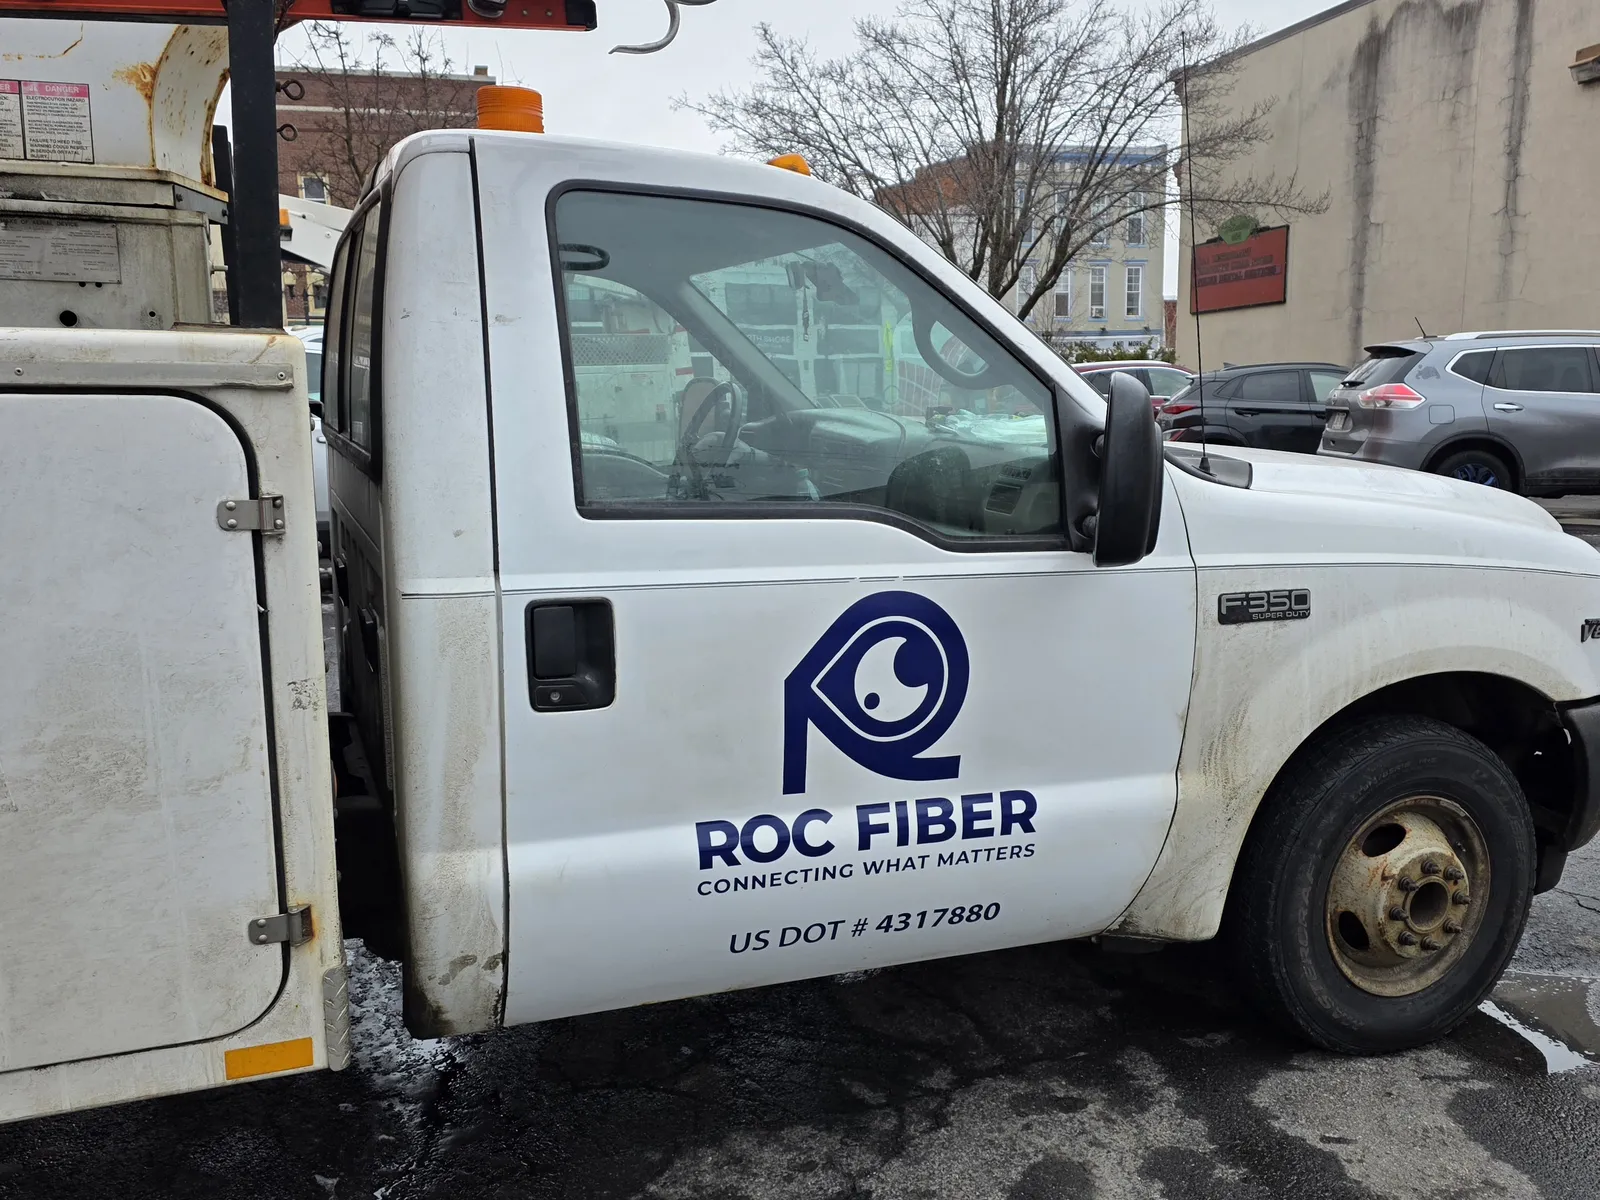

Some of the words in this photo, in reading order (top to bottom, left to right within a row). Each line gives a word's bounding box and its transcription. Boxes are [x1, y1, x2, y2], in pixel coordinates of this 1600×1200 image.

[45, 85, 79, 93] DANGER
[1252, 612, 1283, 620] SUPER
[695, 808, 836, 871] ROC
[856, 790, 1038, 851] FIBER
[697, 864, 853, 896] CONNECTING
[862, 855, 930, 876] WHAT
[937, 843, 1036, 868] MATTERS
[729, 930, 771, 954] US
[778, 919, 846, 948] DOT
[851, 917, 869, 937] #
[876, 902, 1001, 934] 4317880
